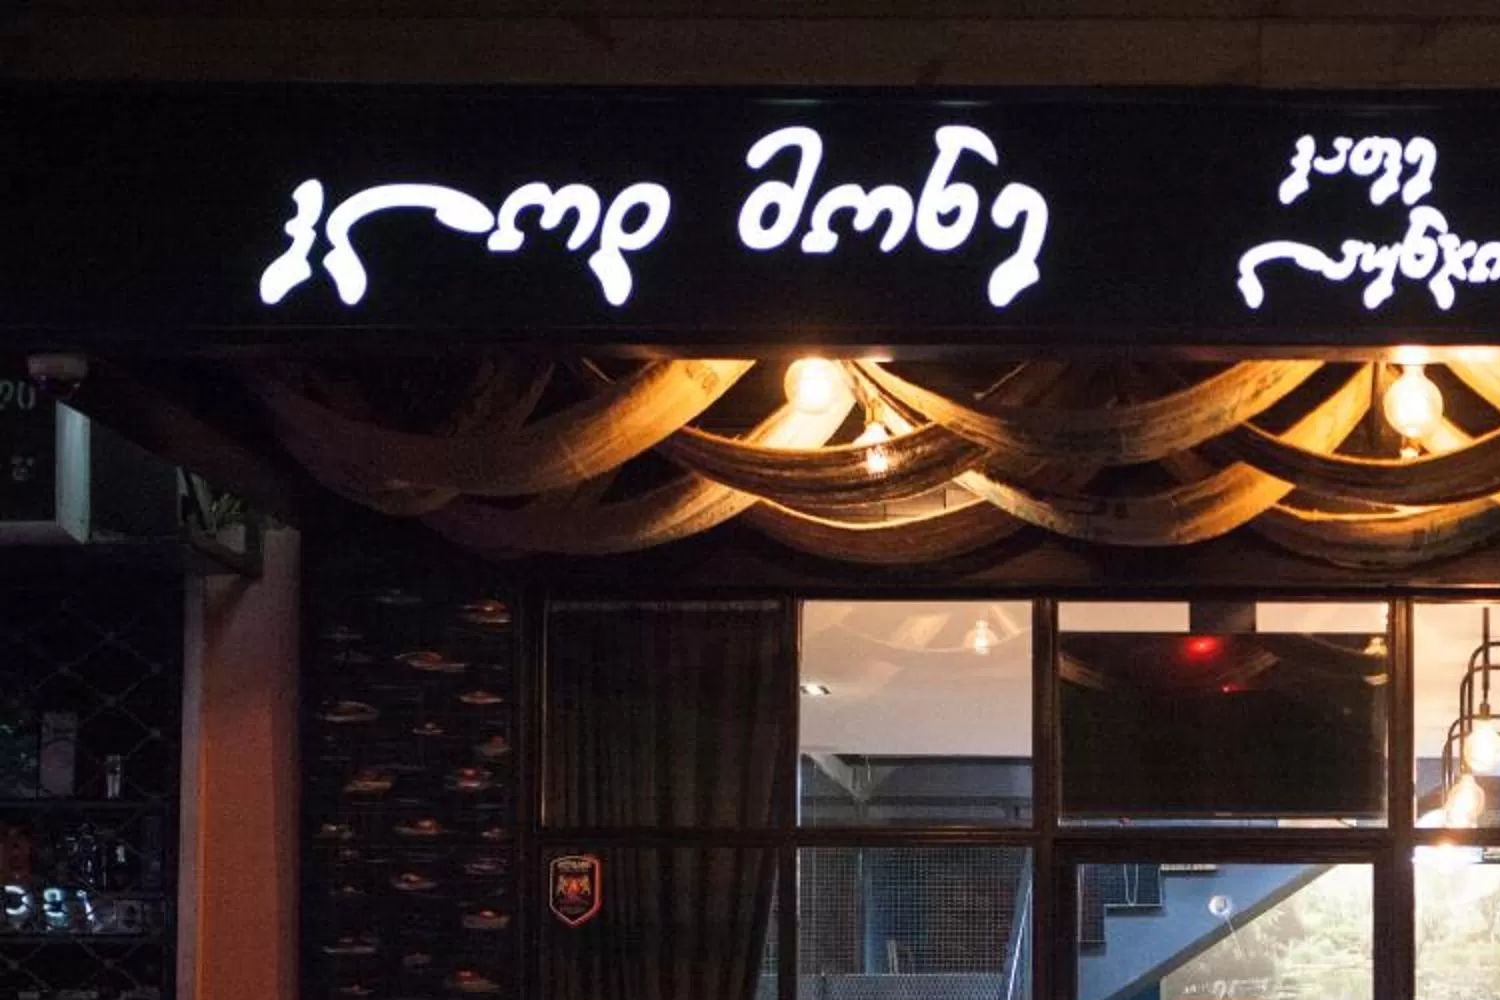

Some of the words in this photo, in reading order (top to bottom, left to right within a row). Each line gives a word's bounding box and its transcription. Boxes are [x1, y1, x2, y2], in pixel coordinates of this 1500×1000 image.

[259, 179, 671, 306] კლოდ
[737, 125, 1049, 307] მონე
[1278, 135, 1437, 205] კაფე
